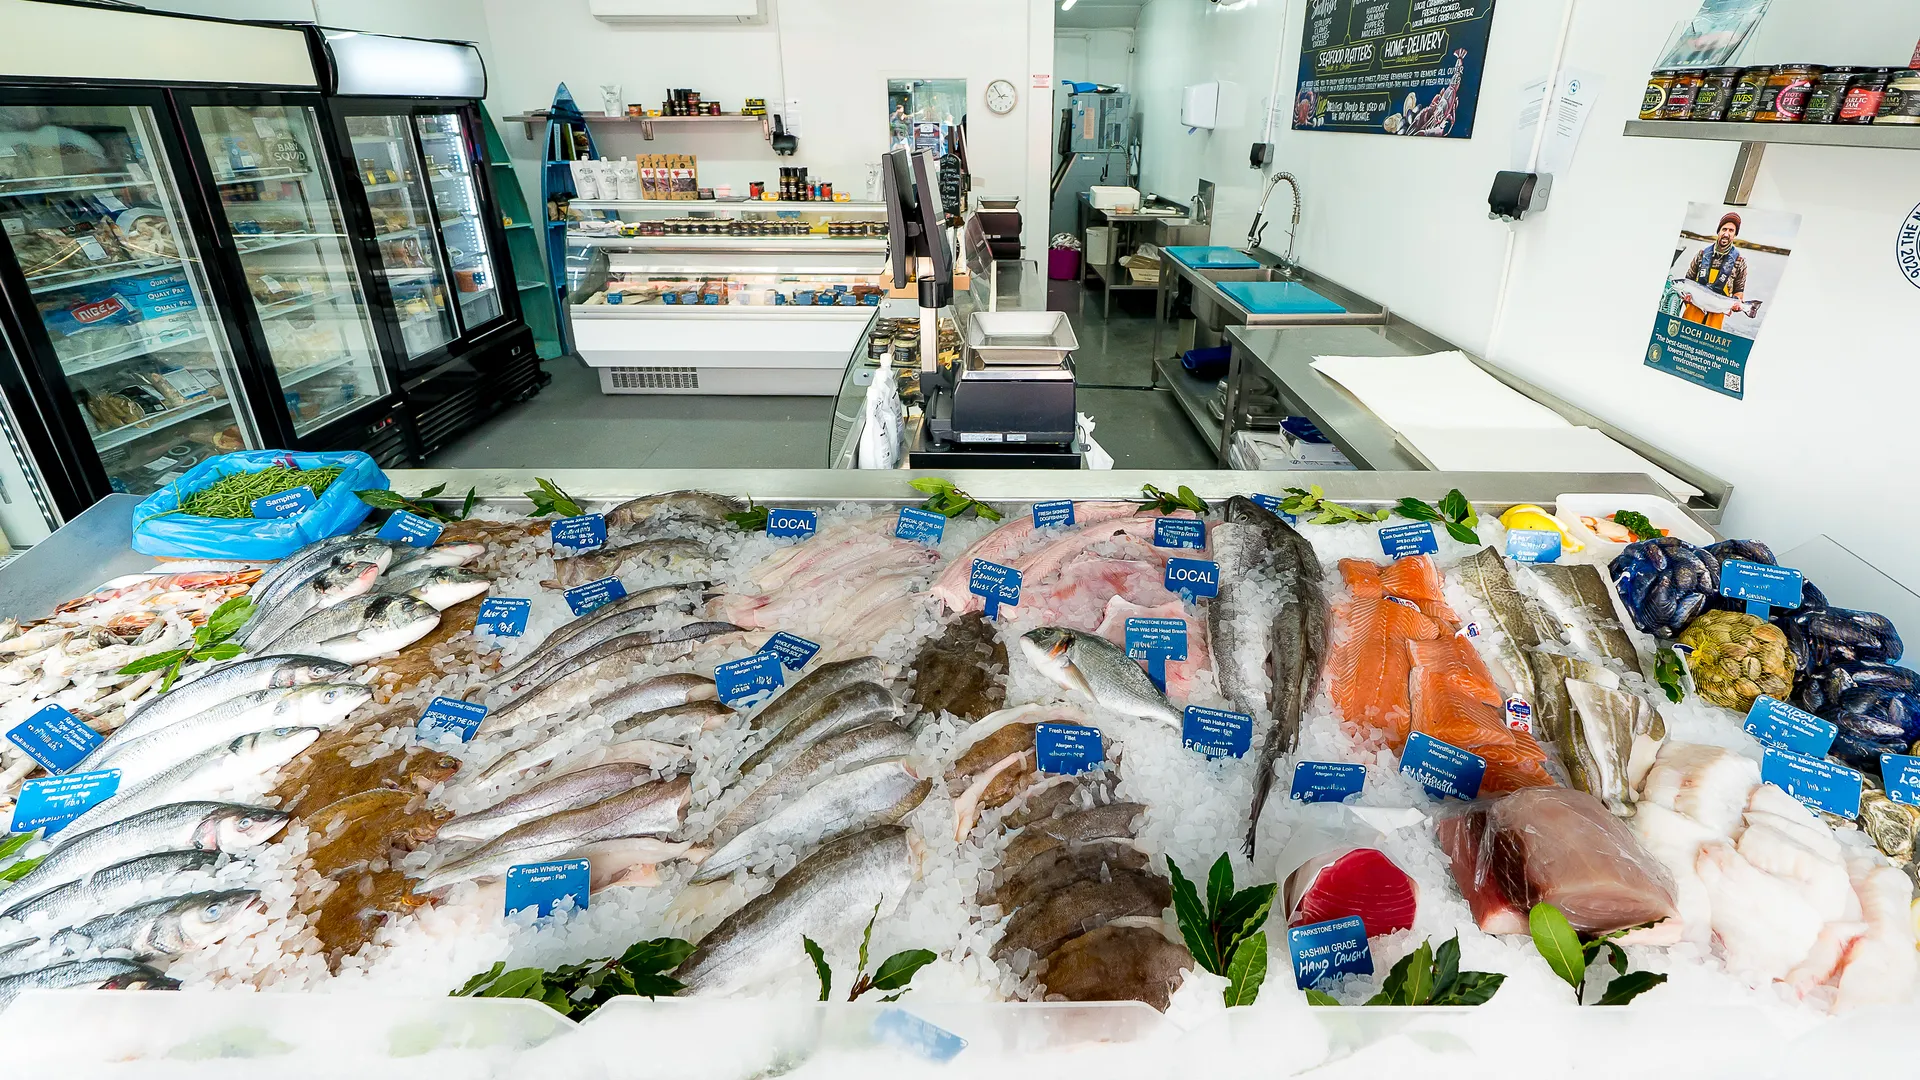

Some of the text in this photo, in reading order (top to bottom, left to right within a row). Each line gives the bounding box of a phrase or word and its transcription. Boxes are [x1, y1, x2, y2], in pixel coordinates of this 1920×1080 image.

[1384, 30, 1445, 58] HOME-DELIVERY
[1318, 48, 1344, 67] SEAFOOD
[1343, 44, 1373, 64] PLATTERS
[277, 142, 298, 151] BABY
[274, 152, 305, 161] SQUID
[1681, 325, 1702, 339] LOCH
[1704, 332, 1732, 348] DUART
[1666, 345, 1722, 370] lowest impact on the
[1695, 349, 1716, 361] salmon
[1715, 355, 1730, 365] with
[1729, 359, 1740, 369] the
[265, 492, 301, 507] Samphire
[275, 501, 298, 512] Grass
[771, 517, 813, 530] LOCAL
[977, 560, 1007, 576] CORNISH
[1736, 562, 1753, 570] Fresh
[1168, 568, 1215, 584] LOCAL
[725, 662, 740, 671] Fresh
[740, 659, 757, 668] Pollock
[426, 711, 447, 721] SPECIAL
[456, 716, 467, 724] THE
[1195, 708, 1224, 718] PARKSTONE
[57, 721, 70, 733] Tiger
[64, 717, 76, 728] Raw
[1197, 716, 1211, 724] Fresh
[1212, 719, 1226, 727] Hake
[1428, 740, 1469, 761] Swordfish Loin
[1428, 748, 1462, 766] Allergen Fish
[1777, 751, 1849, 776] Fresh Monkfish Fillet
[1788, 762, 1832, 779] Allergen Fish
[521, 867, 539, 875] Fresh
[539, 865, 563, 873] Whiting
[1300, 919, 1360, 937] PARKSTONE FISHERIES
[1299, 939, 1357, 959] SASHIMI GRADE
[1299, 945, 1369, 979] HAND CAUGHT
